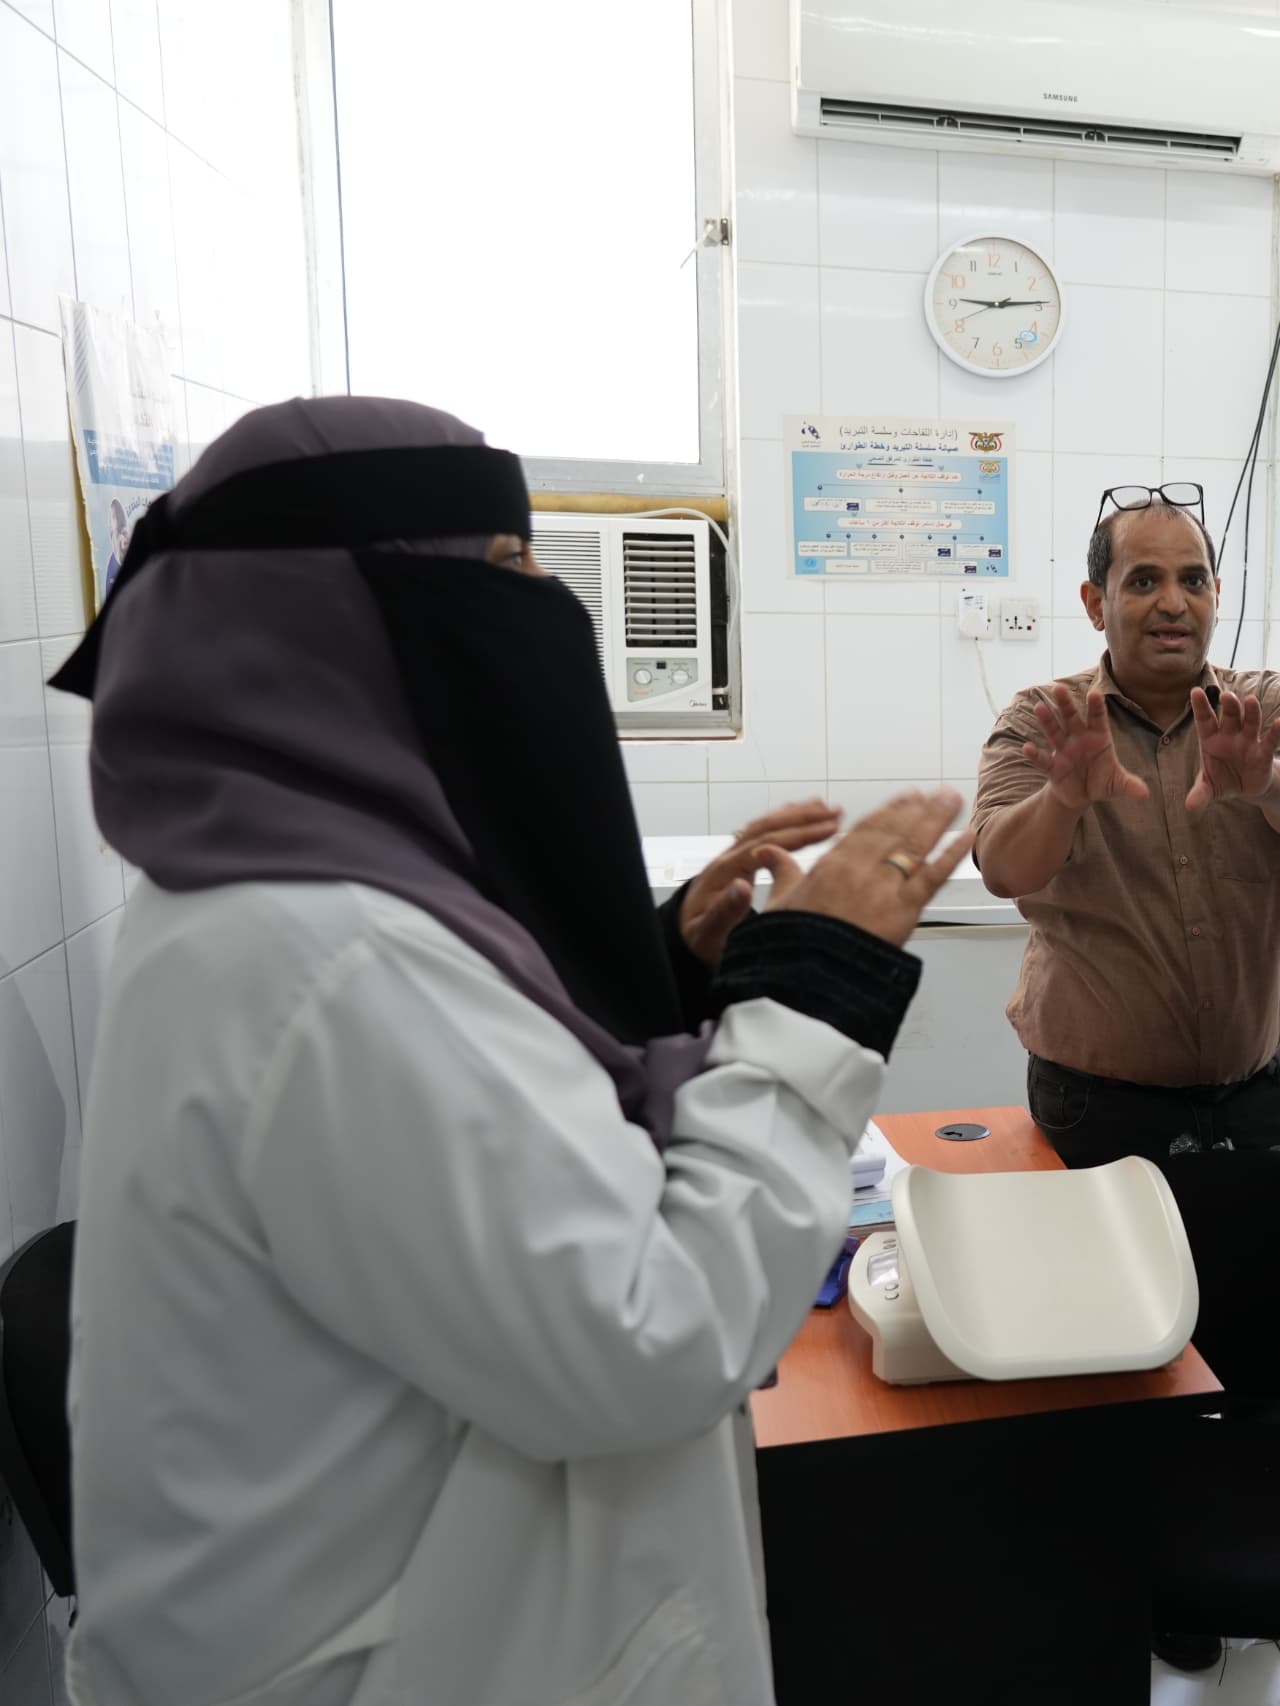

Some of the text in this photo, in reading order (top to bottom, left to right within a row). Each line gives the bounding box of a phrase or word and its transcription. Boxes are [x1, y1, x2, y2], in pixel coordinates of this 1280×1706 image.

[1043, 92, 1078, 102] SAMSUNG
[970, 260, 977, 272] 11
[987, 254, 1001, 268] 12
[951, 274, 966, 288] 10
[1028, 276, 1038, 290] 2
[948, 298, 958, 310] 9
[1034, 300, 1044, 312] 3
[954, 320, 966, 334] 8
[1029, 320, 1038, 333] 4
[972, 337, 980, 349] 7
[992, 342, 1002, 356] 6
[1014, 338, 1023, 350] 5
